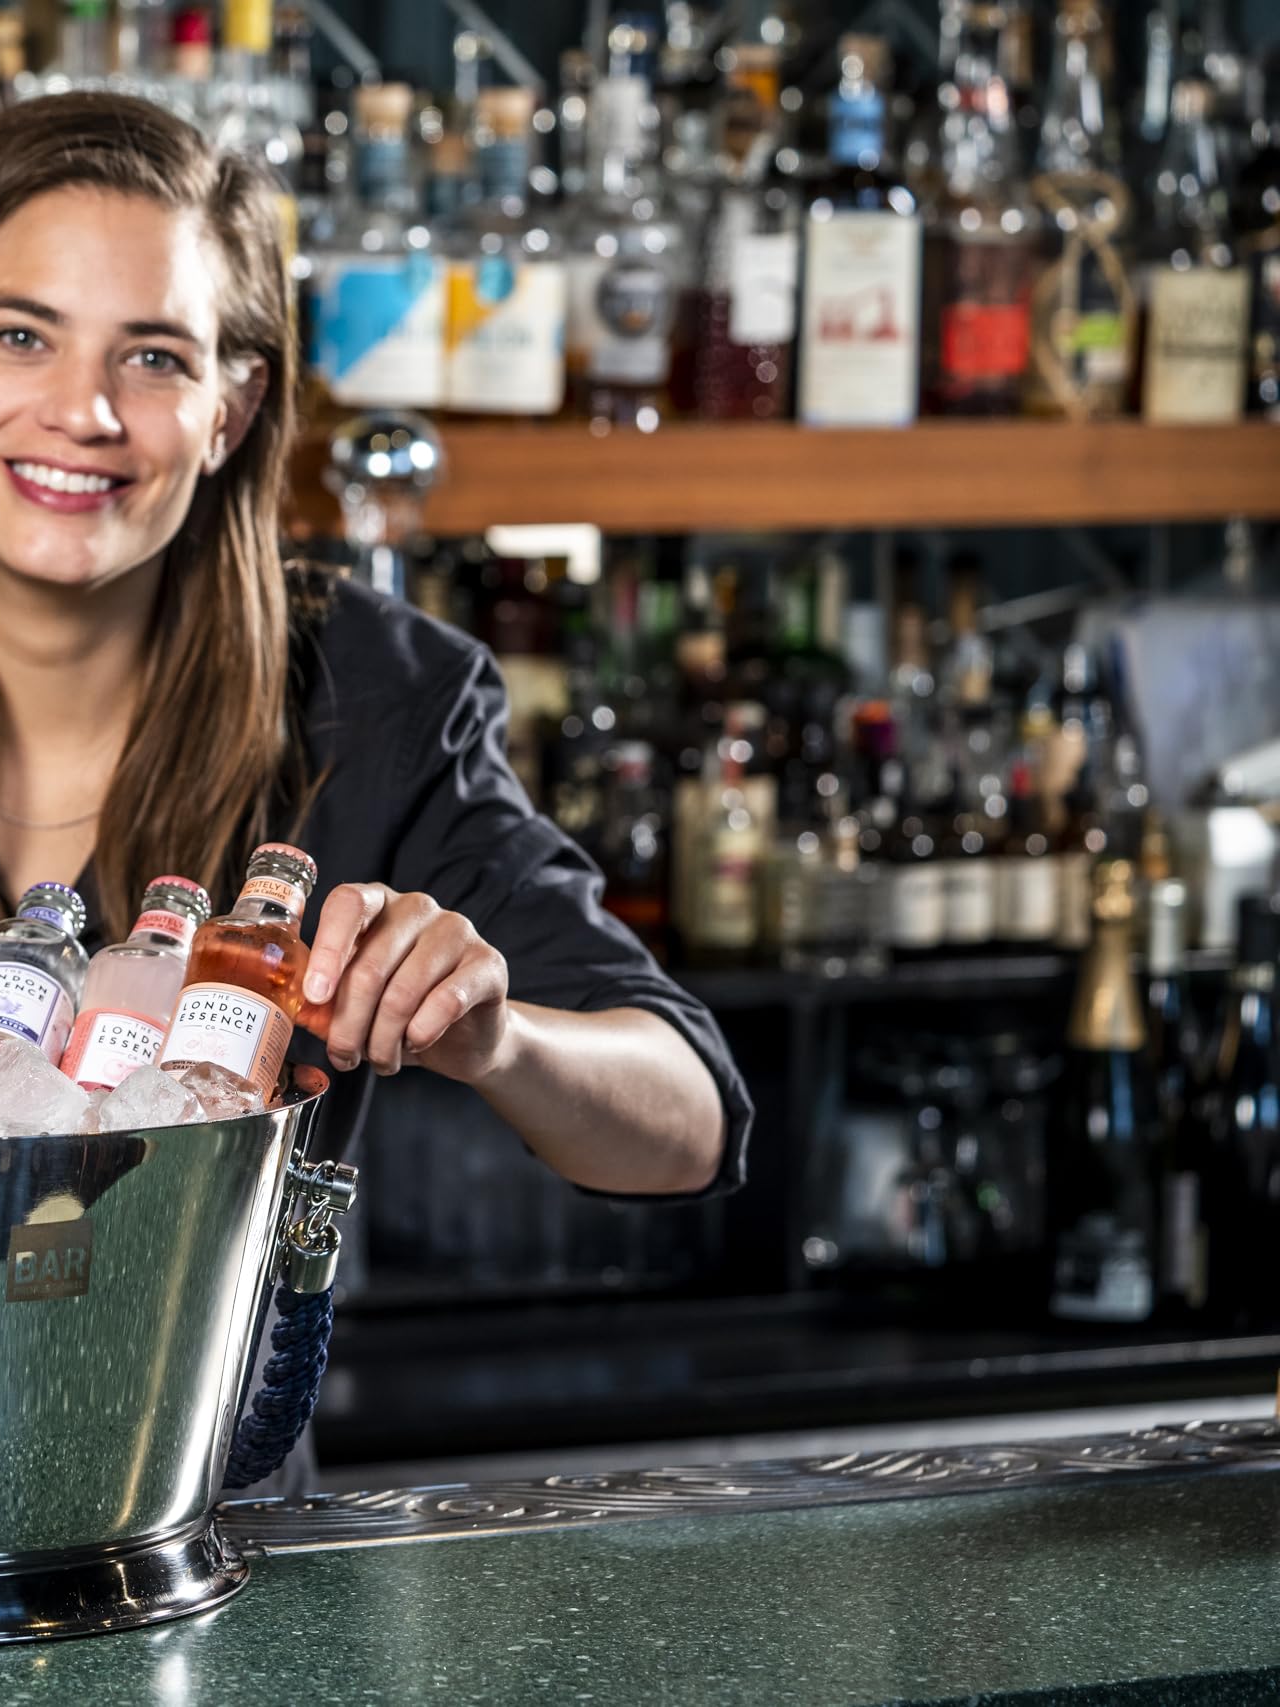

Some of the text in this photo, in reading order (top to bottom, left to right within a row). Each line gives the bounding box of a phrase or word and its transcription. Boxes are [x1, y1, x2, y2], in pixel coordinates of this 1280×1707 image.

[212, 992, 230, 1001] THE
[179, 1011, 254, 1034] ESSENCE
[182, 1000, 257, 1023] LONDON
[101, 1024, 161, 1052] LONDO
[135, 1022, 152, 1034] THE
[98, 1035, 152, 1059] ESSEN
[15, 1247, 86, 1284] BAR
